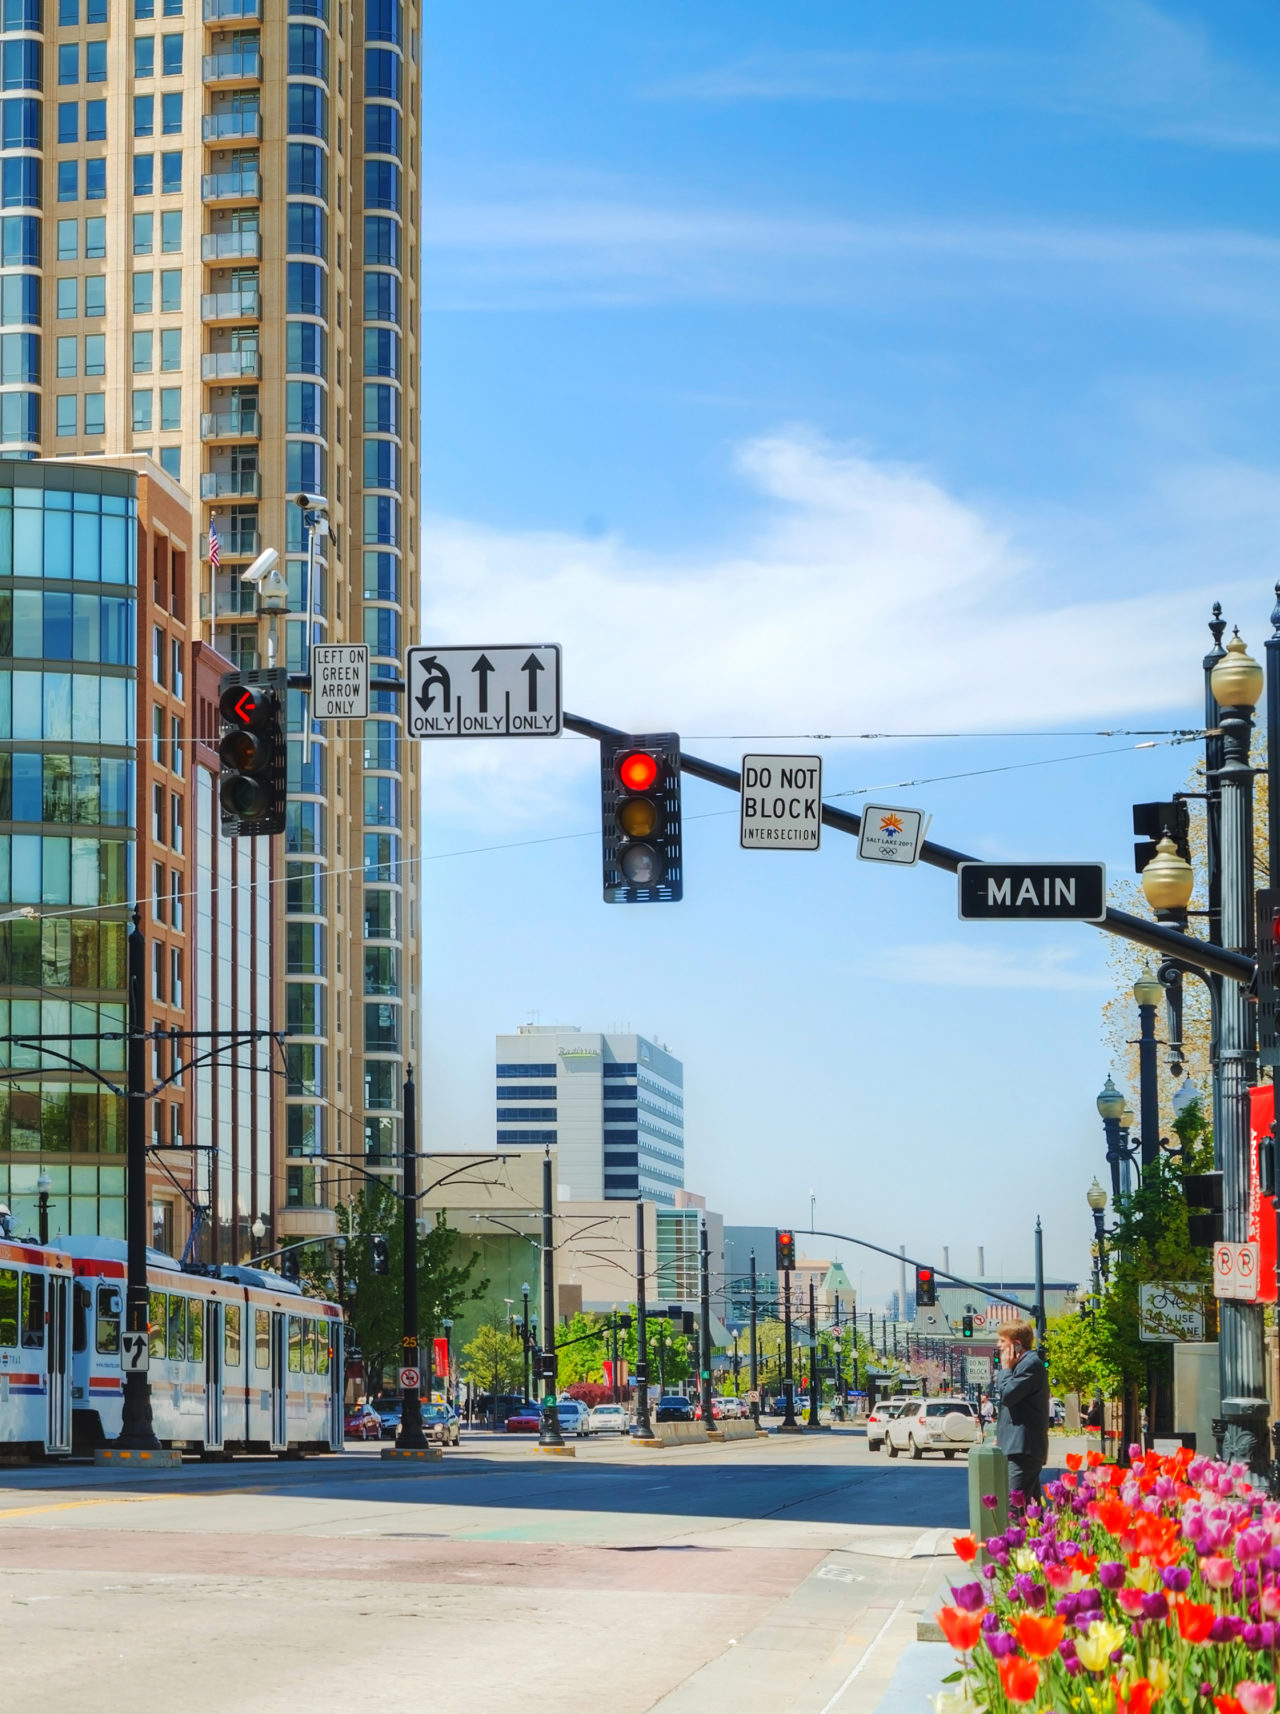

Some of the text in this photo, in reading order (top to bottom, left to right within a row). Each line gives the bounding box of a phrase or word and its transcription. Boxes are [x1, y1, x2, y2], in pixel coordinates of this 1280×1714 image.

[317, 649, 364, 664] LEFT ON
[322, 666, 360, 680] GREEN
[321, 683, 361, 698] ARROW
[326, 700, 355, 715] ONLY
[414, 715, 554, 731] ONLY ONLY ONLY
[746, 767, 818, 790] DO NOT
[745, 797, 817, 819] BLOCK
[744, 828, 817, 841] INTERSECTION
[987, 877, 1076, 906] MAIN
[1175, 1315, 1195, 1324] USE
[403, 1336, 417, 1348] 25
[546, 1396, 554, 1406] 2
